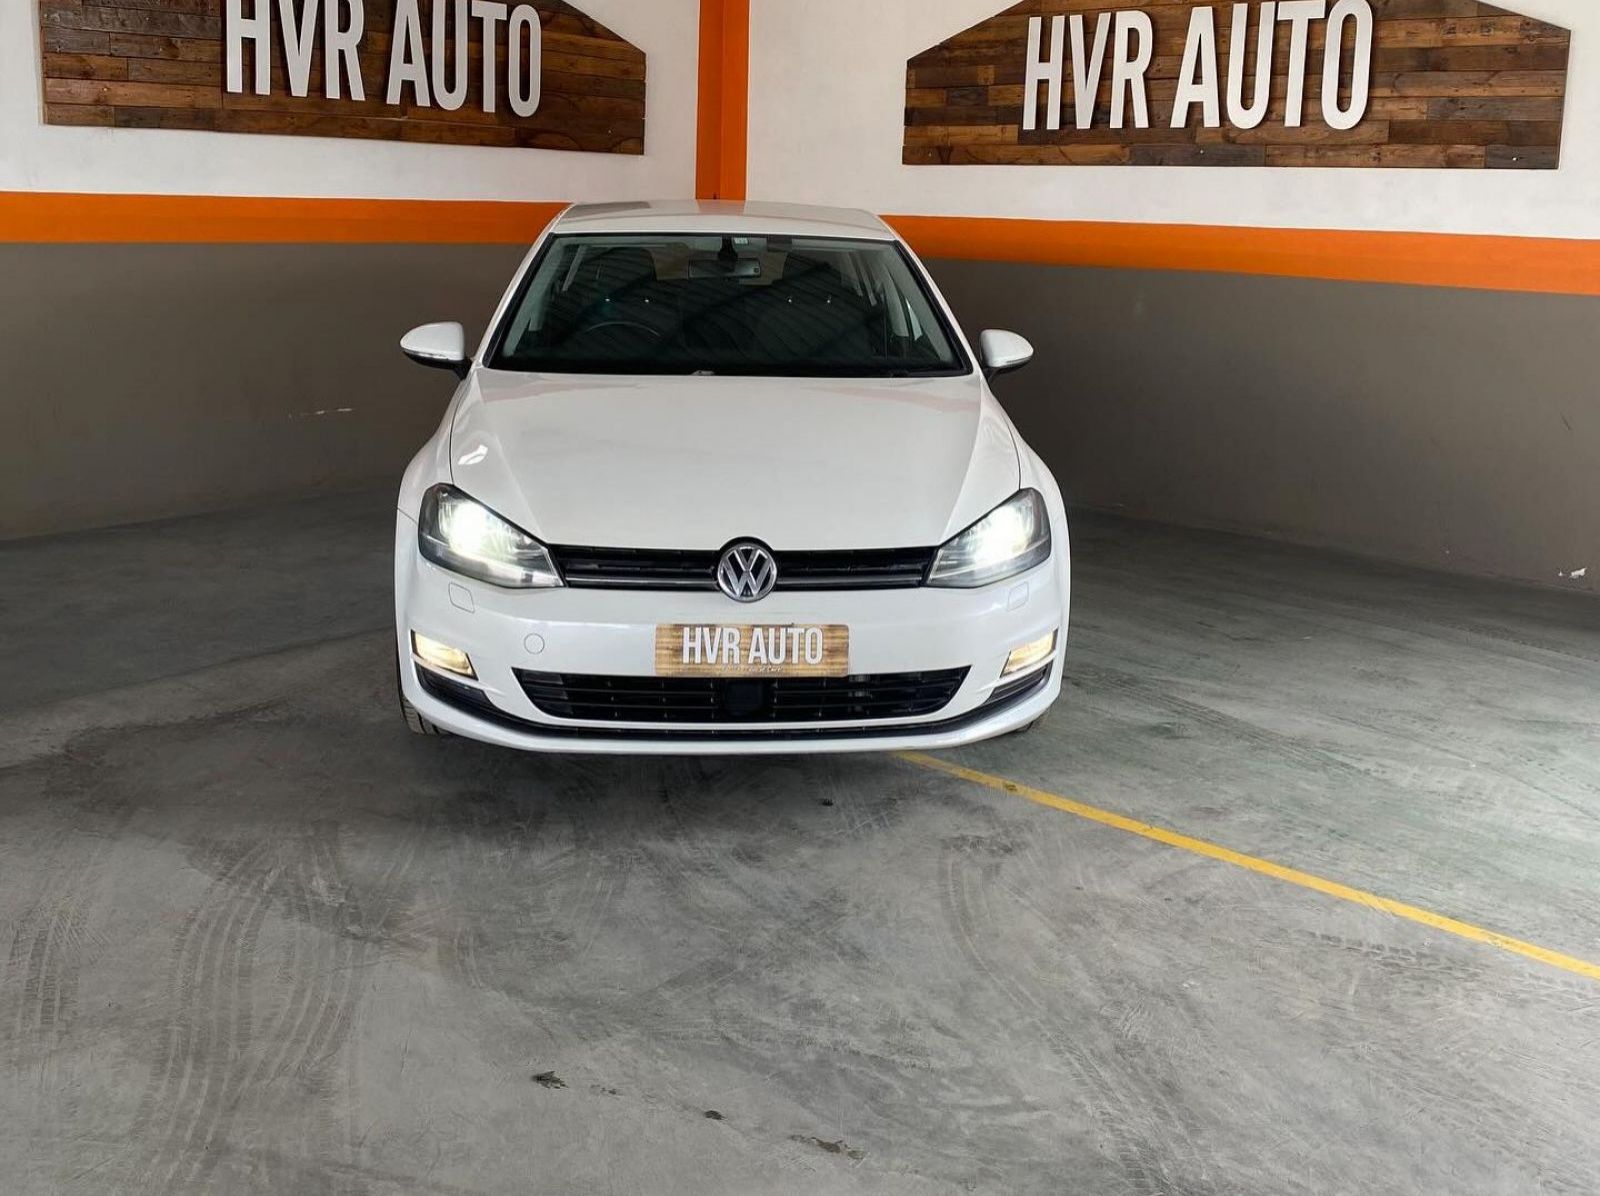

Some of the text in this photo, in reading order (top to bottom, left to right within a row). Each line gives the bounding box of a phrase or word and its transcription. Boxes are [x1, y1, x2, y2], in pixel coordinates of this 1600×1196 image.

[226, 0, 542, 118] HVR AUTO
[1023, 0, 1374, 131] HVR AUTO
[682, 627, 823, 664] HVR AUTO
